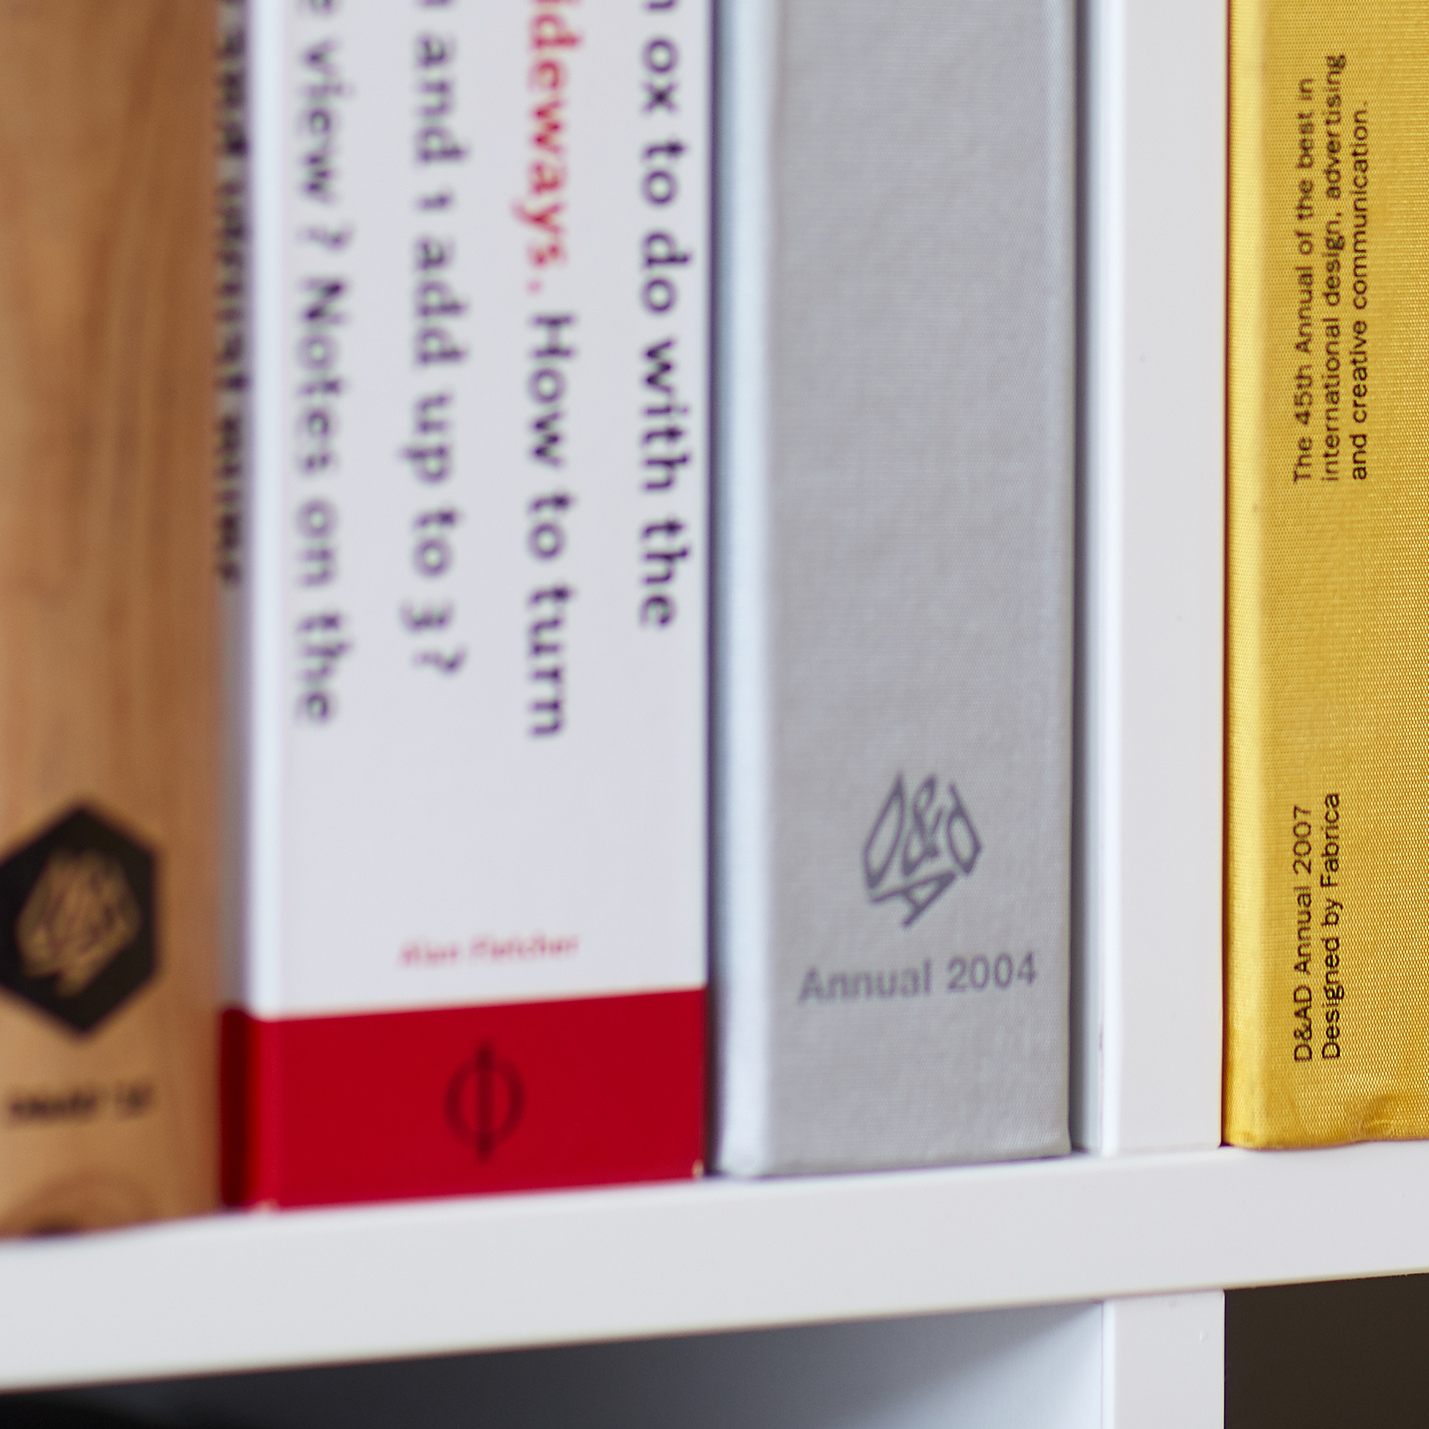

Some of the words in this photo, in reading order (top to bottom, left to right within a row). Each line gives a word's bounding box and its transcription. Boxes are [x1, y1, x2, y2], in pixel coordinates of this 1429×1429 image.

[414, 33, 470, 167] and
[643, 36, 678, 112] ox
[1299, 78, 1314, 100] in
[1298, 112, 1314, 169] best
[1322, 54, 1346, 199] advertising
[642, 139, 687, 207] to
[1297, 180, 1314, 221] the
[1350, 99, 1369, 310] communication.
[641, 231, 692, 315] do
[1295, 231, 1313, 255] of
[1322, 210, 1346, 307] design,
[413, 235, 469, 369] add
[1296, 266, 1313, 353] Annual
[298, 276, 349, 476] Notes
[528, 312, 577, 469] How
[640, 338, 691, 493] with
[1294, 366, 1313, 425] 45th
[1322, 316, 1341, 481] international
[1349, 320, 1368, 424] creative
[400, 391, 453, 486] up
[1293, 436, 1313, 484] The
[1349, 433, 1368, 480] and
[297, 499, 337, 588] on
[412, 506, 461, 579] to
[527, 490, 576, 563] to
[640, 518, 690, 628] the
[297, 612, 351, 723] the
[526, 582, 576, 739] turn
[1292, 806, 1312, 875] 2007
[1320, 792, 1340, 888] Fabrica
[1293, 886, 1312, 975] Annual
[1320, 898, 1344, 927] by
[799, 959, 932, 1000] Annual
[947, 951, 1037, 991] 2004
[1321, 936, 1345, 1061] Designed
[1293, 985, 1313, 1063] D&AD
